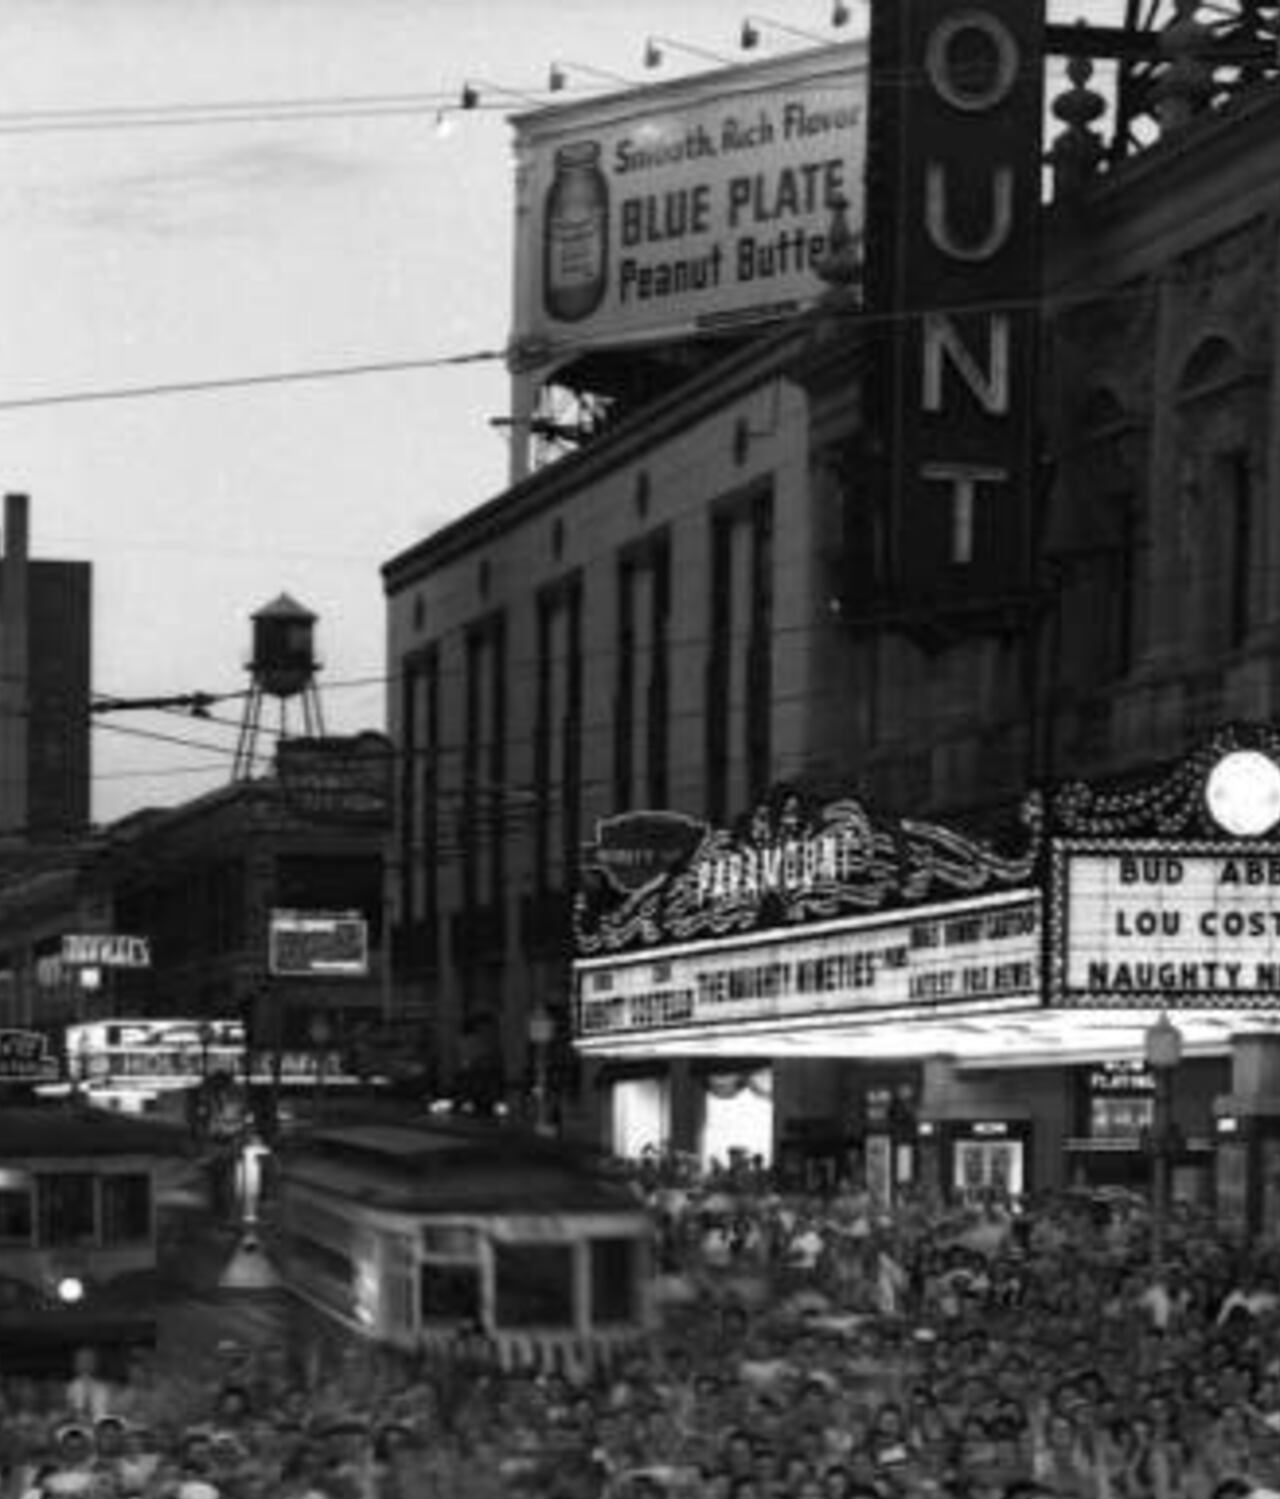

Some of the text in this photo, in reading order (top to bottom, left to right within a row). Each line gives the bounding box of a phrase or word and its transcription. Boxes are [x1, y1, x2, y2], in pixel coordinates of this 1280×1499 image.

[622, 184, 712, 248] BLUE
[728, 158, 850, 229] PLATE
[620, 243, 724, 304] Peanut
[737, 227, 838, 283] Butte
[1119, 859, 1184, 886] BUD
[1116, 912, 1181, 938] LOU
[1088, 961, 1243, 990] NAUGHTY
